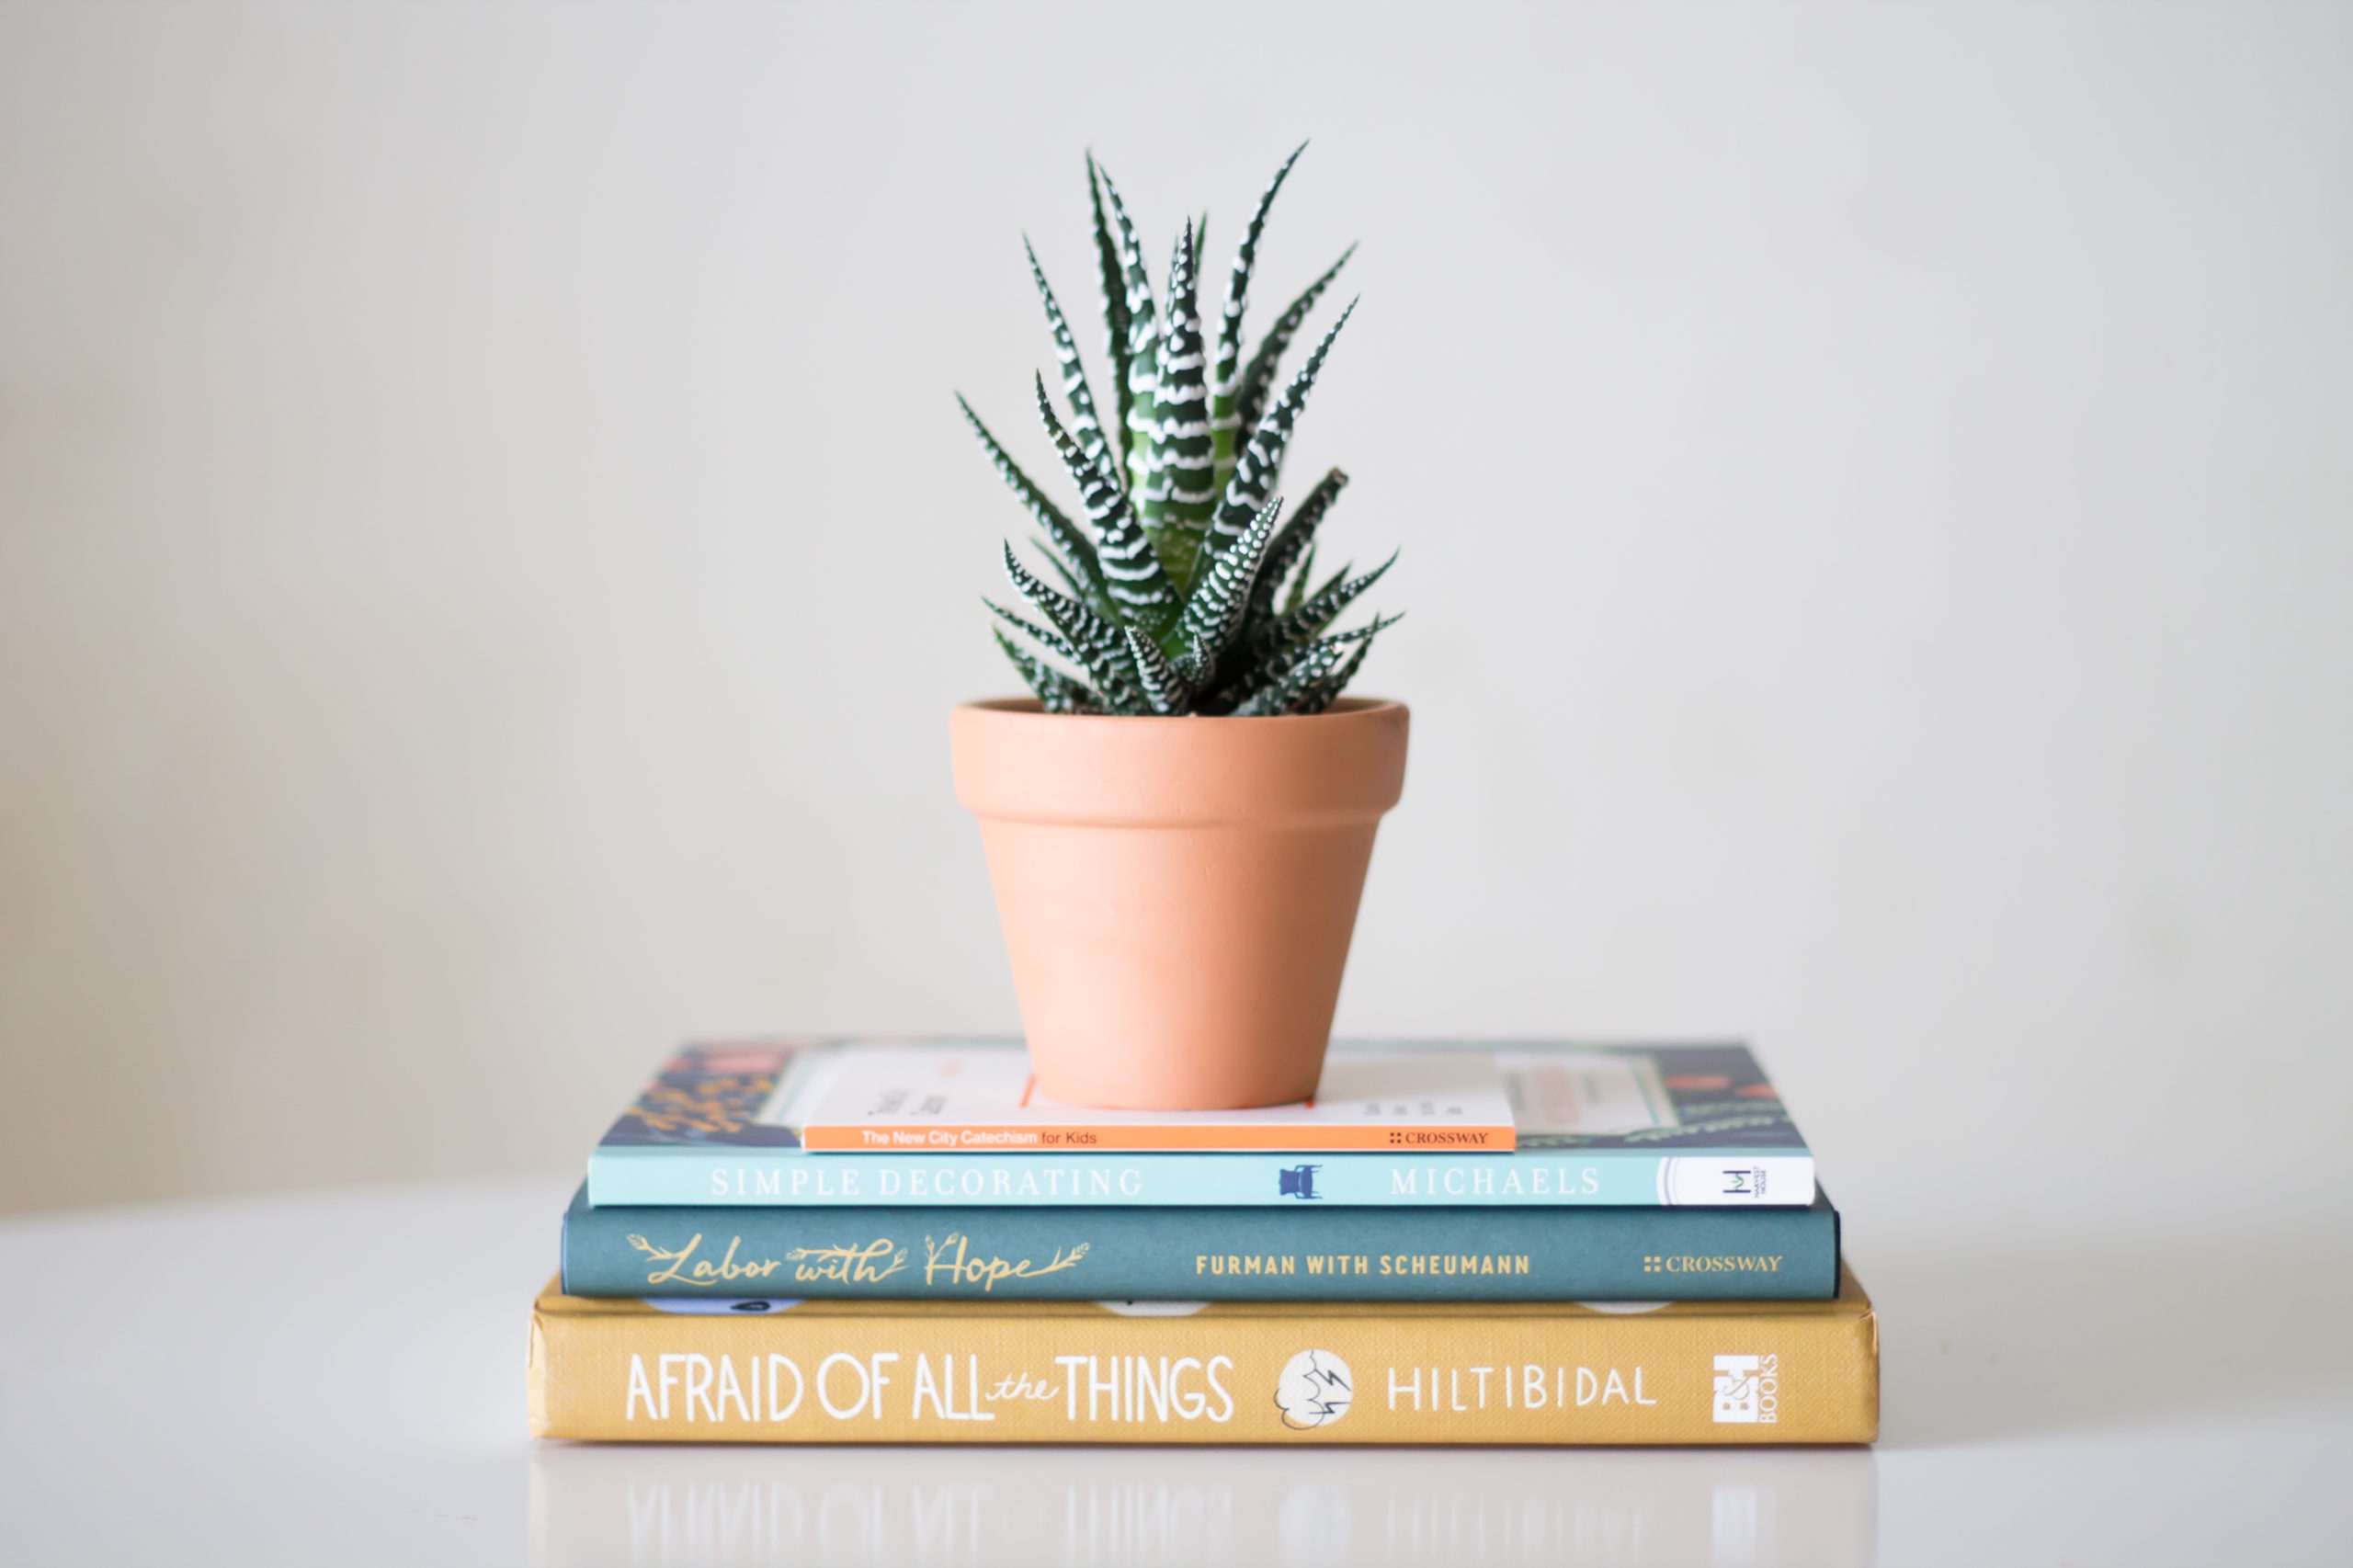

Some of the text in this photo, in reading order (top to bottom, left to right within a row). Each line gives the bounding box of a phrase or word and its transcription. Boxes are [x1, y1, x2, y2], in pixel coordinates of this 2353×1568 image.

[862, 1131, 1097, 1146] The New City Catechism for Kids
[1405, 1132, 1489, 1144] CROSSWAY
[710, 1168, 1142, 1195] SIMPLE DECORATING
[1391, 1168, 1600, 1195] MICHAELS
[640, 1233, 1062, 1292] Labor with Hope
[1196, 1256, 1530, 1275] FURMAN WITH SCHEUMANN
[1665, 1256, 1782, 1272] CROSSWAY
[626, 1353, 1234, 1422] AFRAID OF ALL the THINGS
[1388, 1365, 1657, 1412] HILTIBIDAL
[1759, 1353, 1778, 1423] BOOKS
